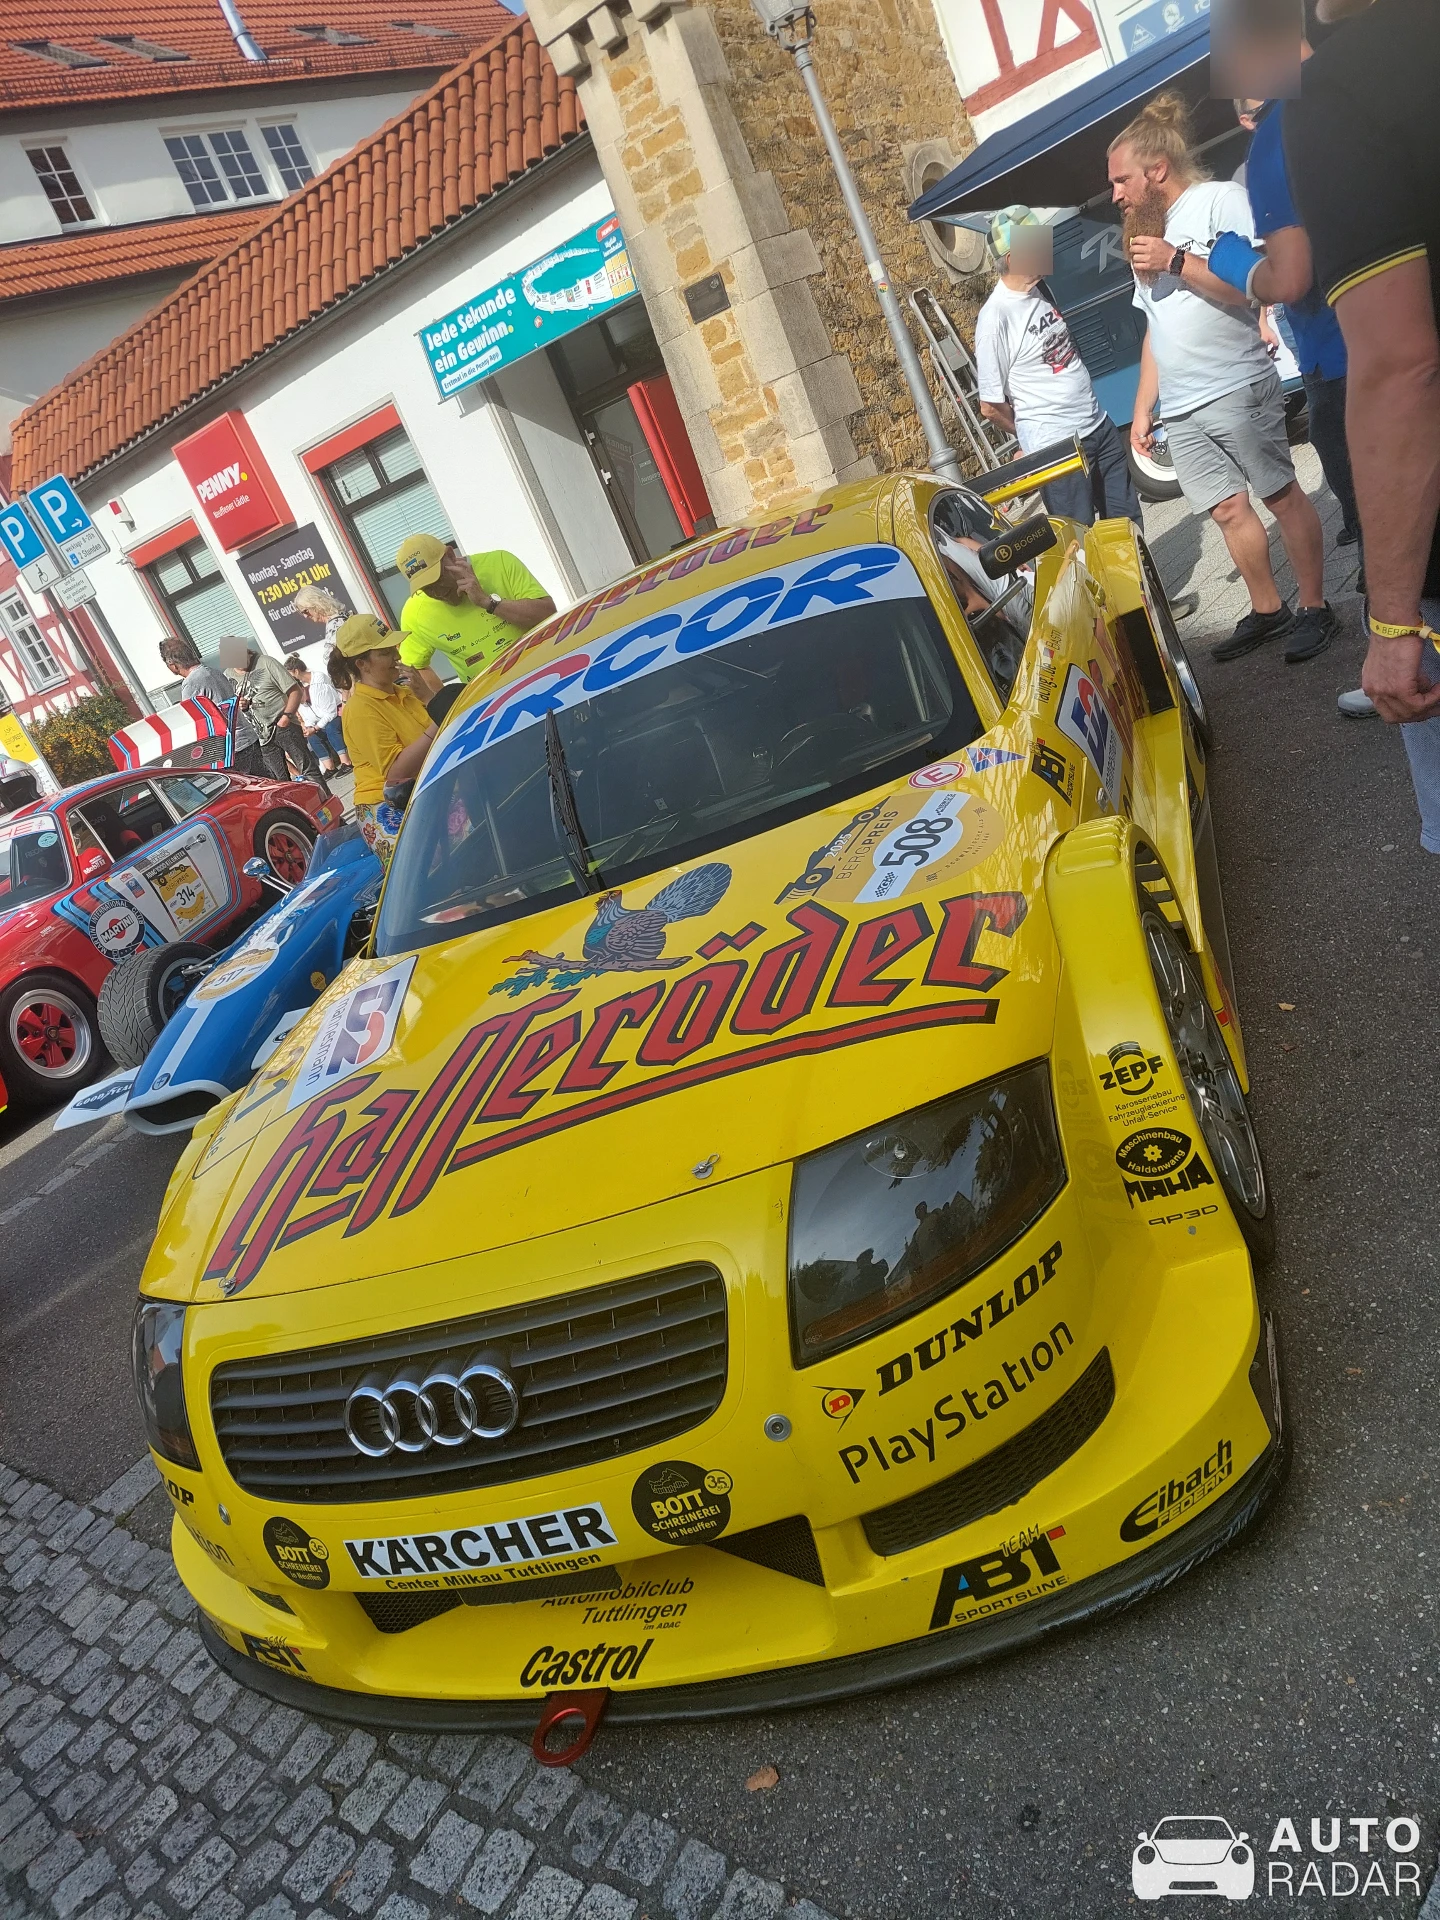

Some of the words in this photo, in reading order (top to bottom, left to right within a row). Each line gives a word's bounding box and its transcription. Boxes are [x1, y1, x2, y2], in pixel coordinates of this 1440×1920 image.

[426, 319, 458, 351] Jede
[457, 286, 516, 333] Sekunde
[434, 348, 458, 373] ein
[489, 350, 500, 366] App
[40, 490, 67, 534] P
[233, 494, 250, 508] Lädle
[1, 516, 25, 559] P
[82, 543, 102, 558] Stunden
[1013, 526, 1048, 551] BOGNER
[248, 563, 279, 585] Montag
[280, 547, 315, 570] Samstag
[258, 583, 283, 605] 7:30
[279, 576, 299, 595] bis
[295, 570, 313, 588] 21
[309, 563, 332, 582] Uhr
[268, 608, 281, 622] für
[824, 833, 851, 859] 2025
[836, 810, 899, 881] BERGPREIS
[879, 817, 954, 867] 508
[176, 886, 196, 906] 314
[91, 900, 128, 924] INTERNATIONAL
[132, 907, 144, 925] CLUB
[90, 926, 107, 955] MARTINI
[100, 914, 134, 943] MARTINI
[306, 997, 350, 1087] mannesmann
[1099, 1055, 1164, 1090] ZEPF
[1108, 1093, 1186, 1123] Fahrzeuglackierung
[1115, 1089, 1173, 1112] Karosseriebau
[1122, 1104, 1178, 1127] Unfall-Service
[1118, 1130, 1183, 1159] Maschinenbau
[1127, 1149, 1186, 1174] Haldenwang
[1121, 1151, 1214, 1210] MAHA
[876, 1240, 1062, 1396] DUNLOP
[838, 1320, 1074, 1484] PlayStation
[706, 1475, 727, 1489] 35
[1120, 1438, 1232, 1542] Eibach
[1157, 1463, 1233, 1528] FEDERN
[650, 1488, 705, 1520] BOTT
[651, 1504, 721, 1532] SCHREINEREI
[345, 1507, 616, 1577] KÄRCHER
[668, 1530, 679, 1539] in
[680, 1519, 718, 1537] Neuffen
[1000, 1523, 1040, 1557] TEAM
[275, 1544, 309, 1563] BOTT
[310, 1540, 326, 1556] 35
[278, 1560, 323, 1573] SCHREINEREI
[290, 1571, 297, 1579] in
[296, 1572, 323, 1581] Neuffen
[385, 1577, 442, 1591] Center
[445, 1571, 502, 1588] Milkau
[504, 1552, 602, 1580] Tuttlingen
[928, 1535, 1064, 1631] ABT
[581, 1602, 688, 1624] Tuttlingen
[954, 1575, 1069, 1622] SPORTSLINE
[656, 1621, 681, 1629] ADAC
[520, 1638, 655, 1689] Castrol
